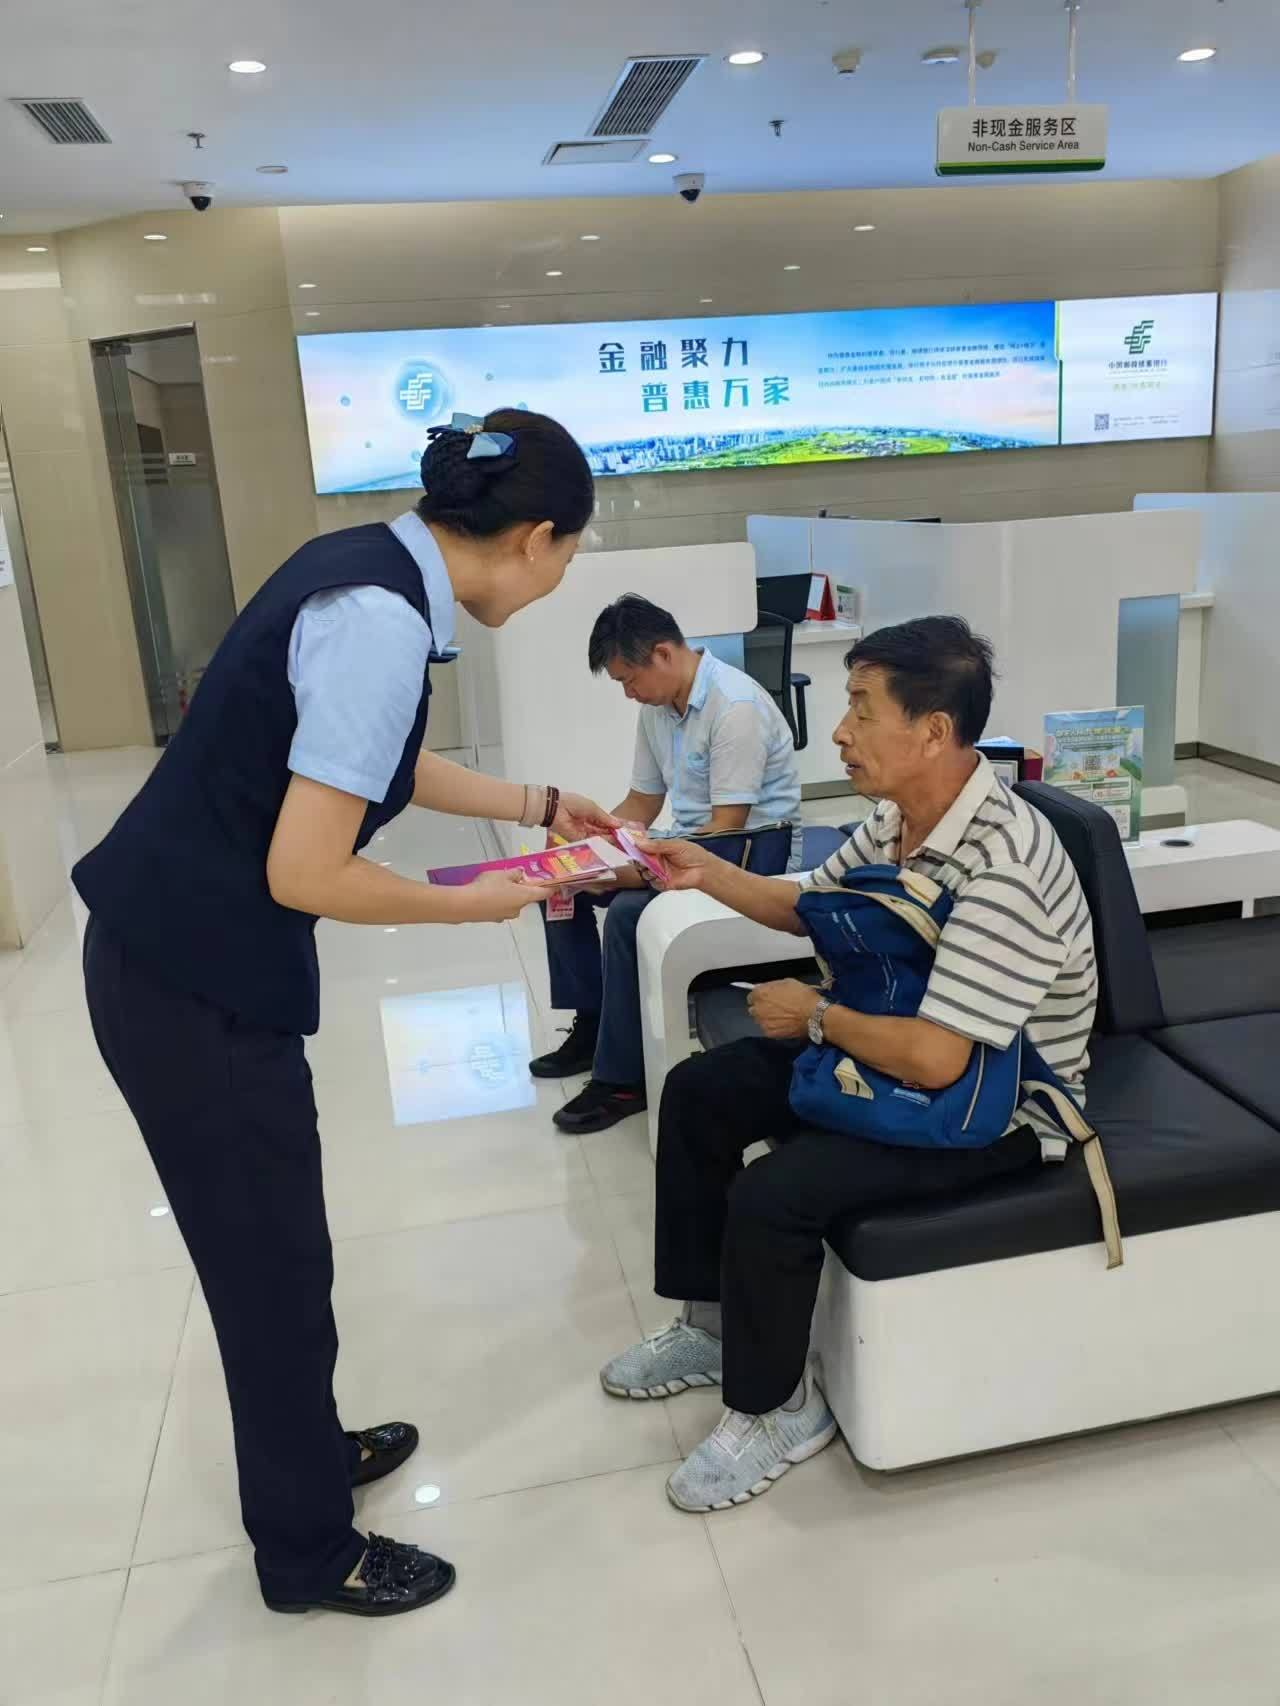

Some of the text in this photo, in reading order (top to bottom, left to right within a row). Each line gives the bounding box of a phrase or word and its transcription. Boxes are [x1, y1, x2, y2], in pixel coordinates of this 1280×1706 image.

[972, 117, 1077, 138] 非现金服务区
[967, 140, 1080, 153] Non-Cash Service Area
[598, 337, 749, 373] 金融聚力
[641, 375, 790, 413] 普惠万家
